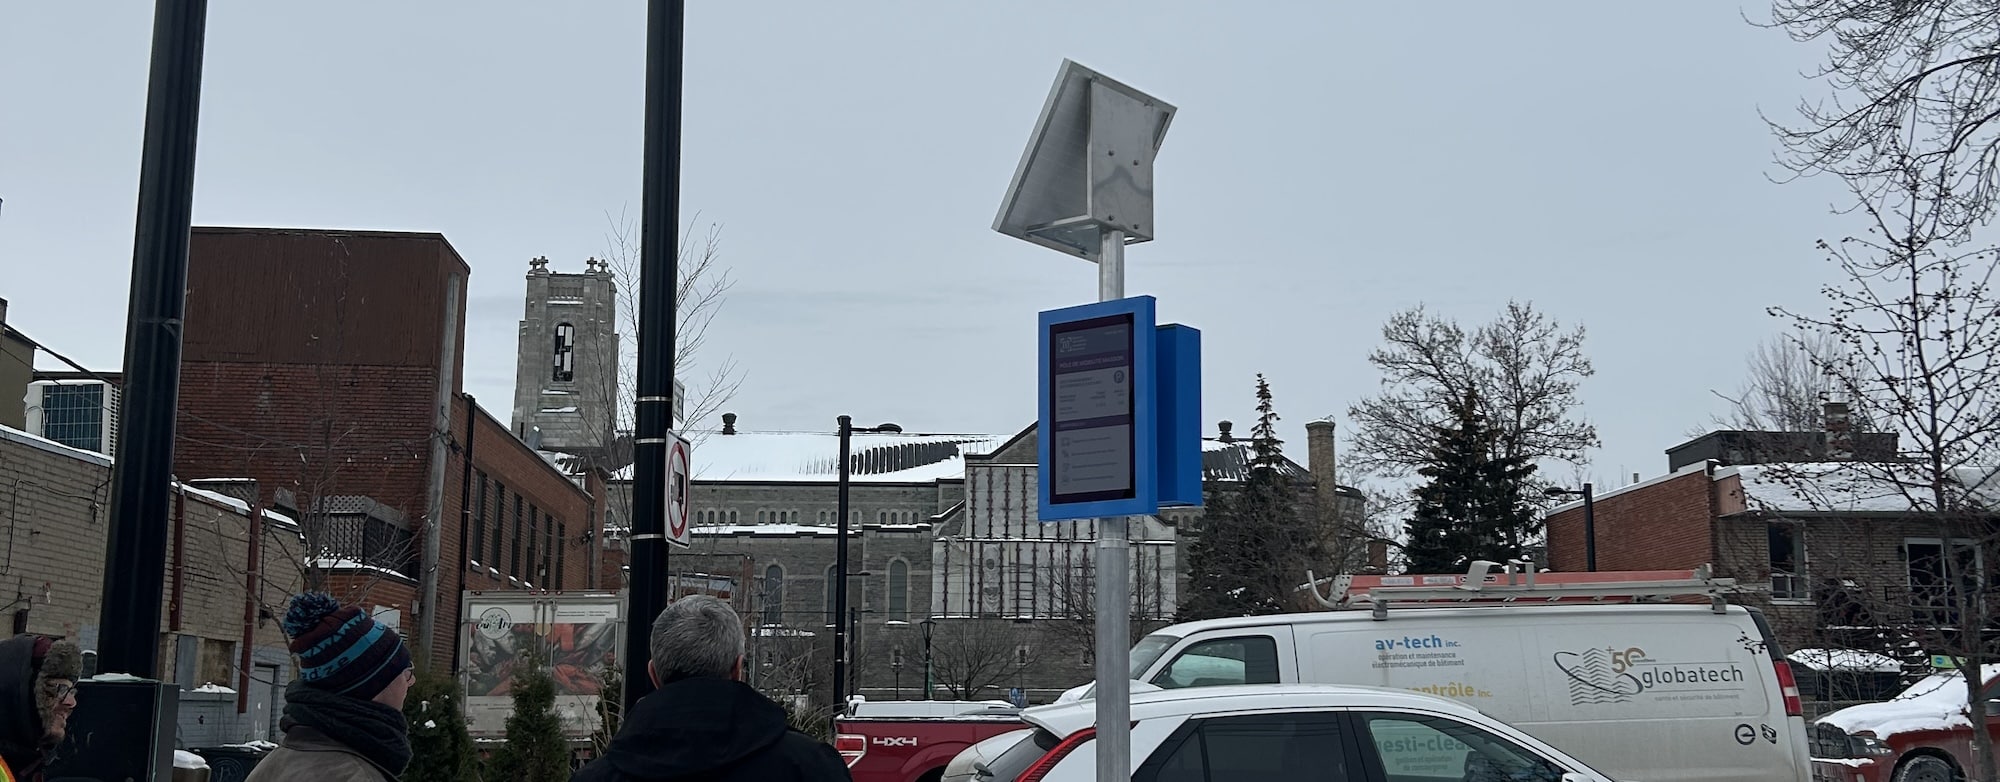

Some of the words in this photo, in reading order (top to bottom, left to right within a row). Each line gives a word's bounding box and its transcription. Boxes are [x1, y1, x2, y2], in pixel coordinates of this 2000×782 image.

[1375, 634, 1442, 650] av-tech
[1445, 640, 1462, 648] inc.
[1642, 664, 1744, 689] globatech
